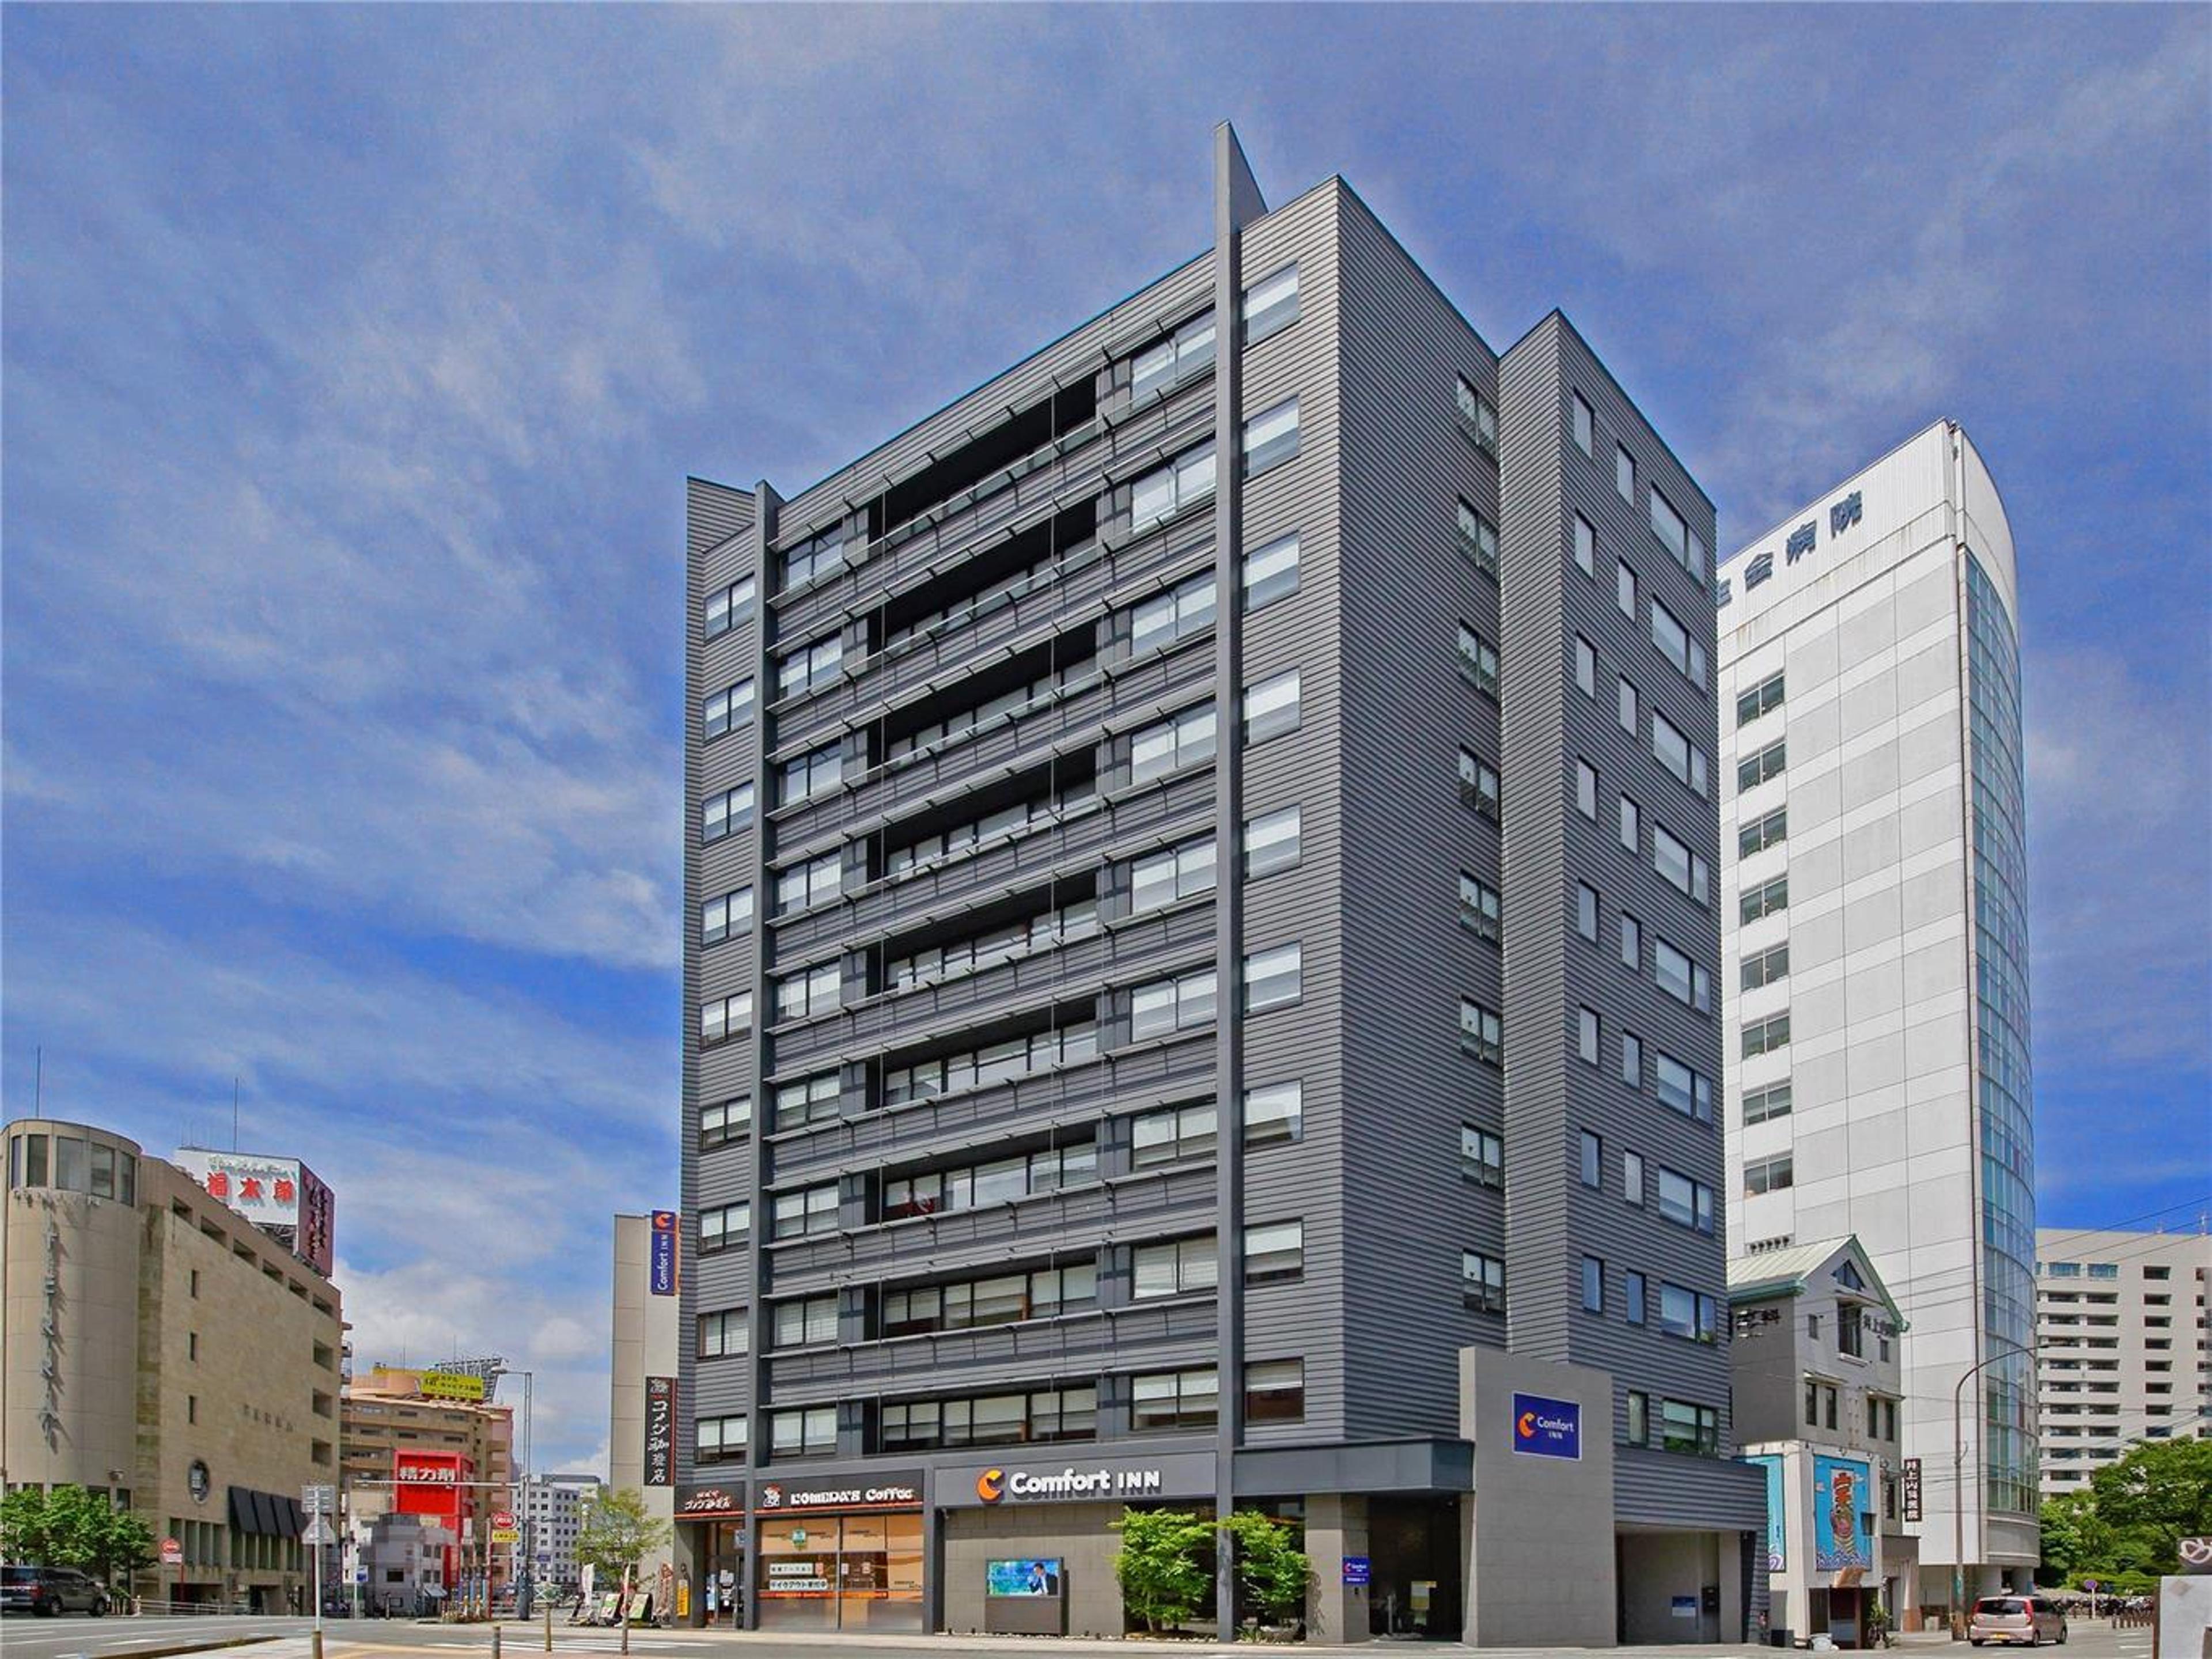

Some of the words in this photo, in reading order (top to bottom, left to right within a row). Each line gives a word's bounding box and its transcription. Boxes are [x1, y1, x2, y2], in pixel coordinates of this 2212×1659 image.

[207, 1171, 293, 1203] 福太郎
[657, 1252, 668, 1290] Comfort
[1537, 1416, 1574, 1433] Comfort
[1010, 1468, 1111, 1494] Comfort
[1118, 1470, 1160, 1488] INN
[866, 1487, 914, 1502] Coffee
